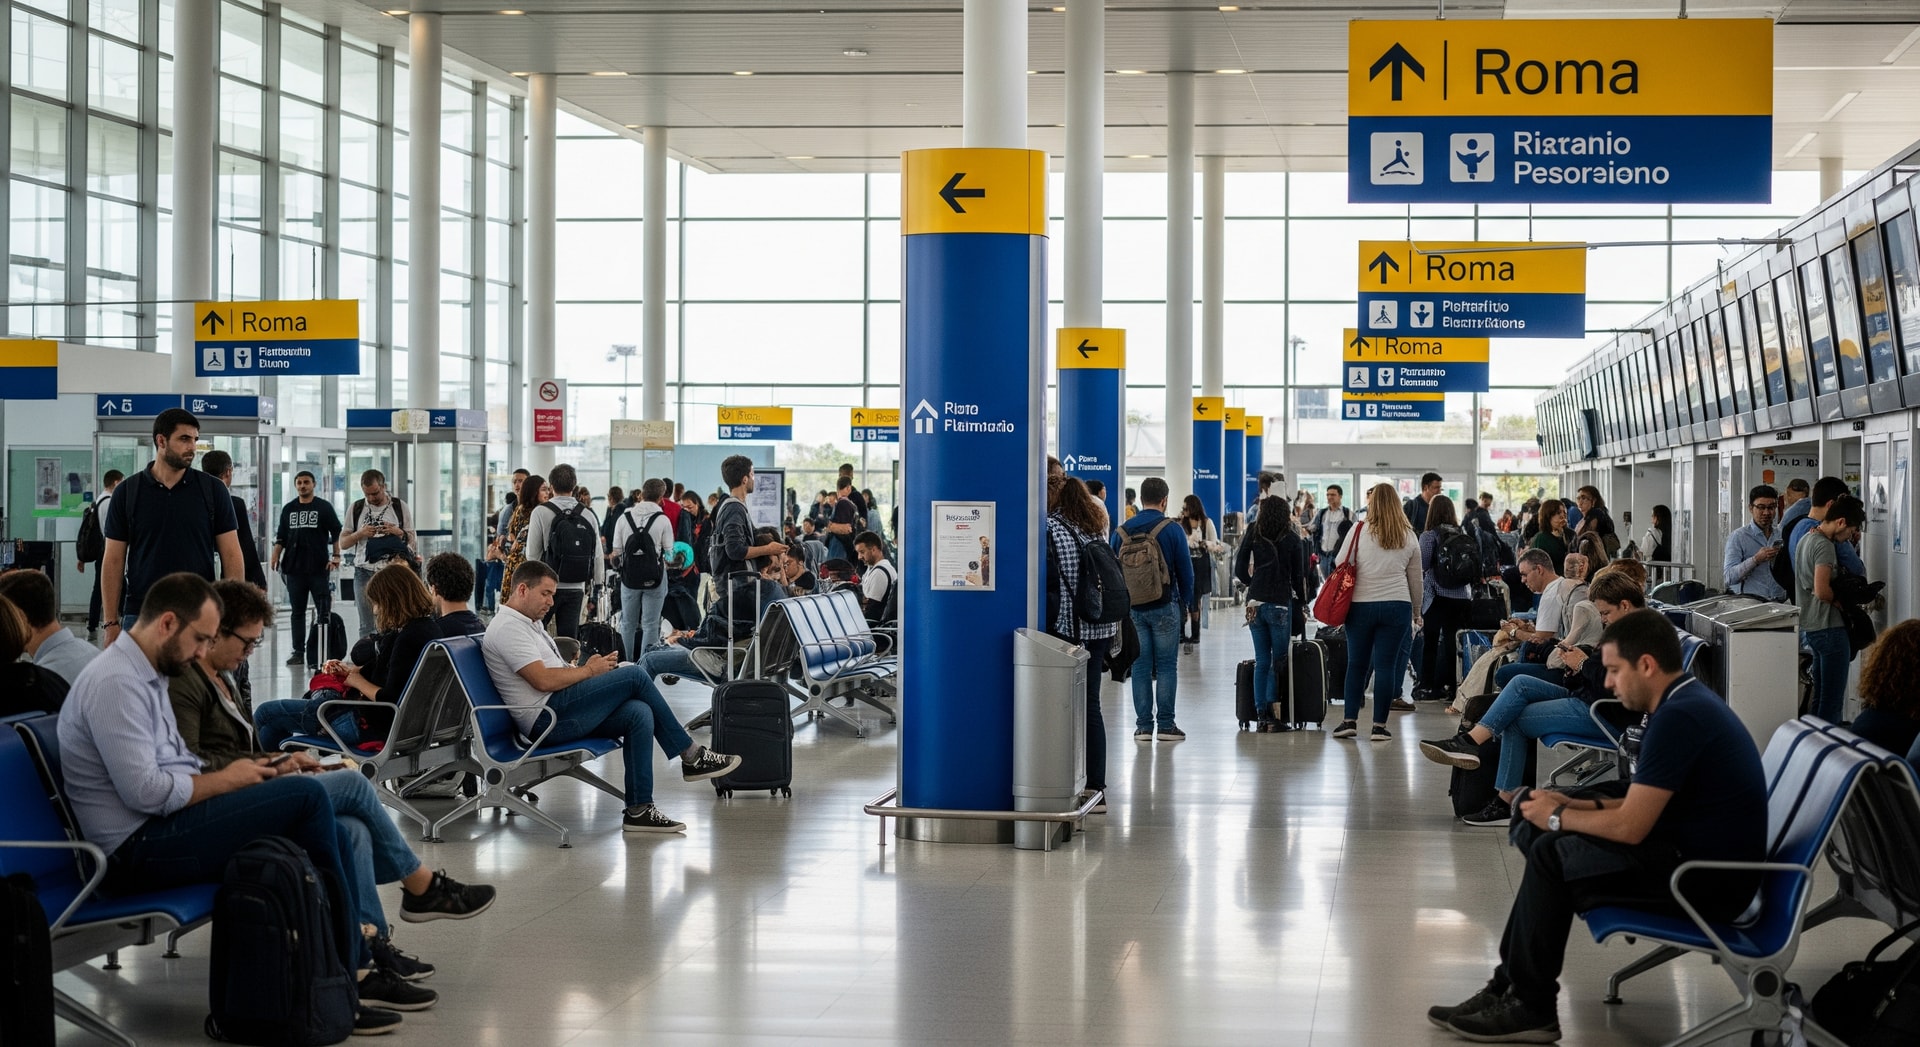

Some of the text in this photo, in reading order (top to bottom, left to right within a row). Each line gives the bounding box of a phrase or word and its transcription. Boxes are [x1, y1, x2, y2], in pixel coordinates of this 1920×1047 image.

[1476, 48, 1638, 95] Roma
[1426, 255, 1515, 282] Roma
[242, 311, 307, 332] Roma
[1385, 337, 1443, 355] Roma
